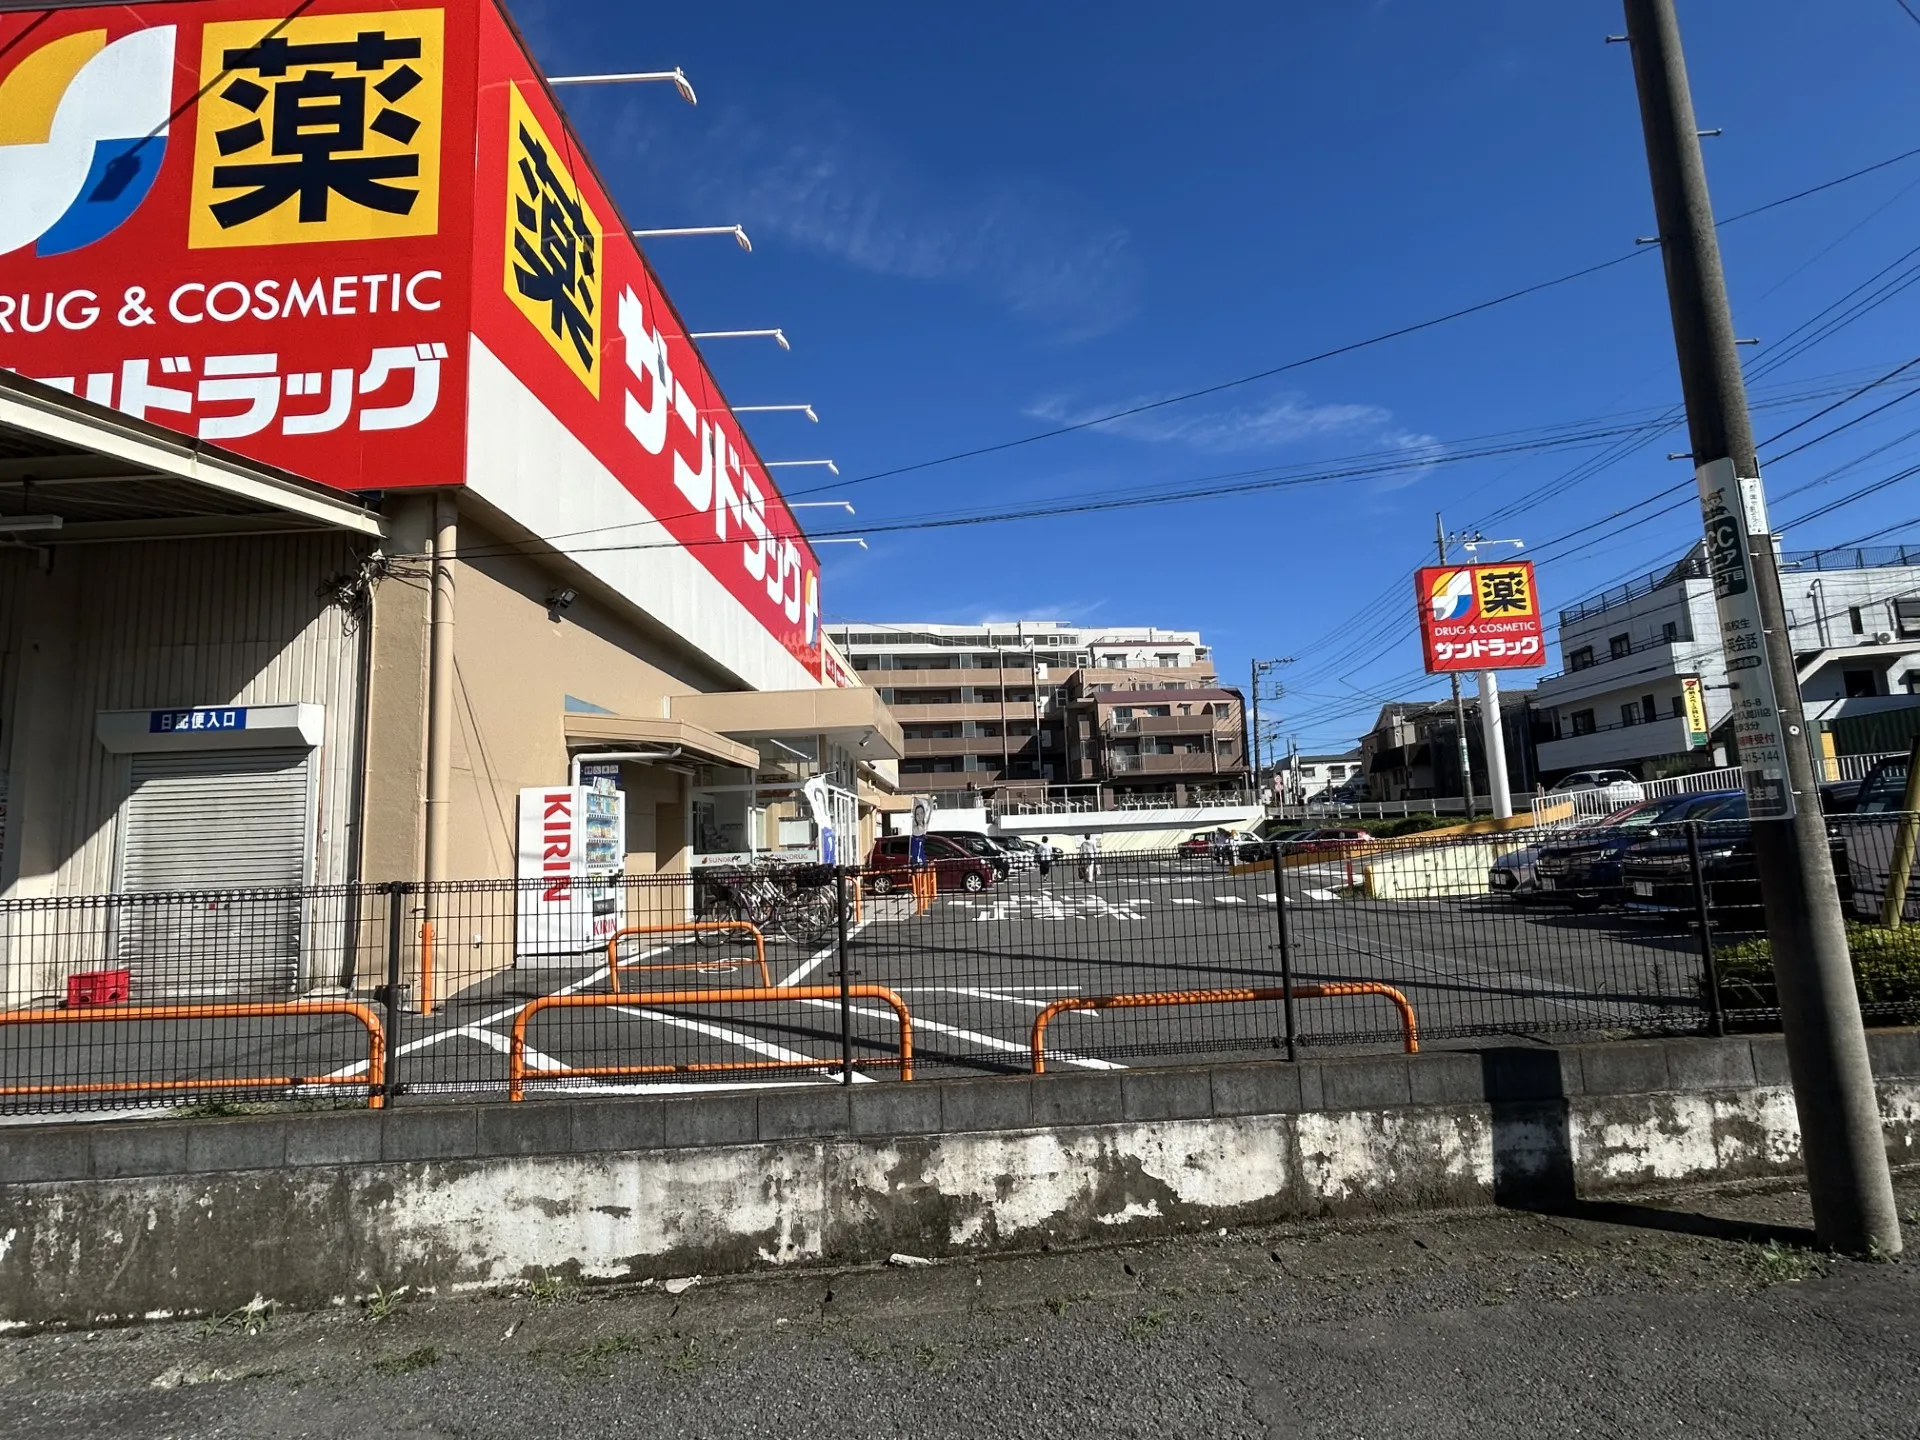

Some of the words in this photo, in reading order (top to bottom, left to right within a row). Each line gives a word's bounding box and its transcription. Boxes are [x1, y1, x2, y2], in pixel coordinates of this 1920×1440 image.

[209, 31, 422, 229] 薬
[515, 120, 595, 371] 薬
[117, 286, 156, 327] &
[168, 270, 442, 324] COSMETIC
[618, 282, 801, 624] サンドラッグ
[1480, 571, 1527, 614] 薬
[1434, 624, 1466, 637] DRUG
[1468, 624, 1478, 635] &
[1479, 621, 1536, 634] COSMETIC
[1434, 635, 1539, 660] サンドラッグ
[160, 711, 236, 730] 日配便入口
[543, 793, 571, 902] KIRIN
[592, 917, 617, 936] KIRIN
